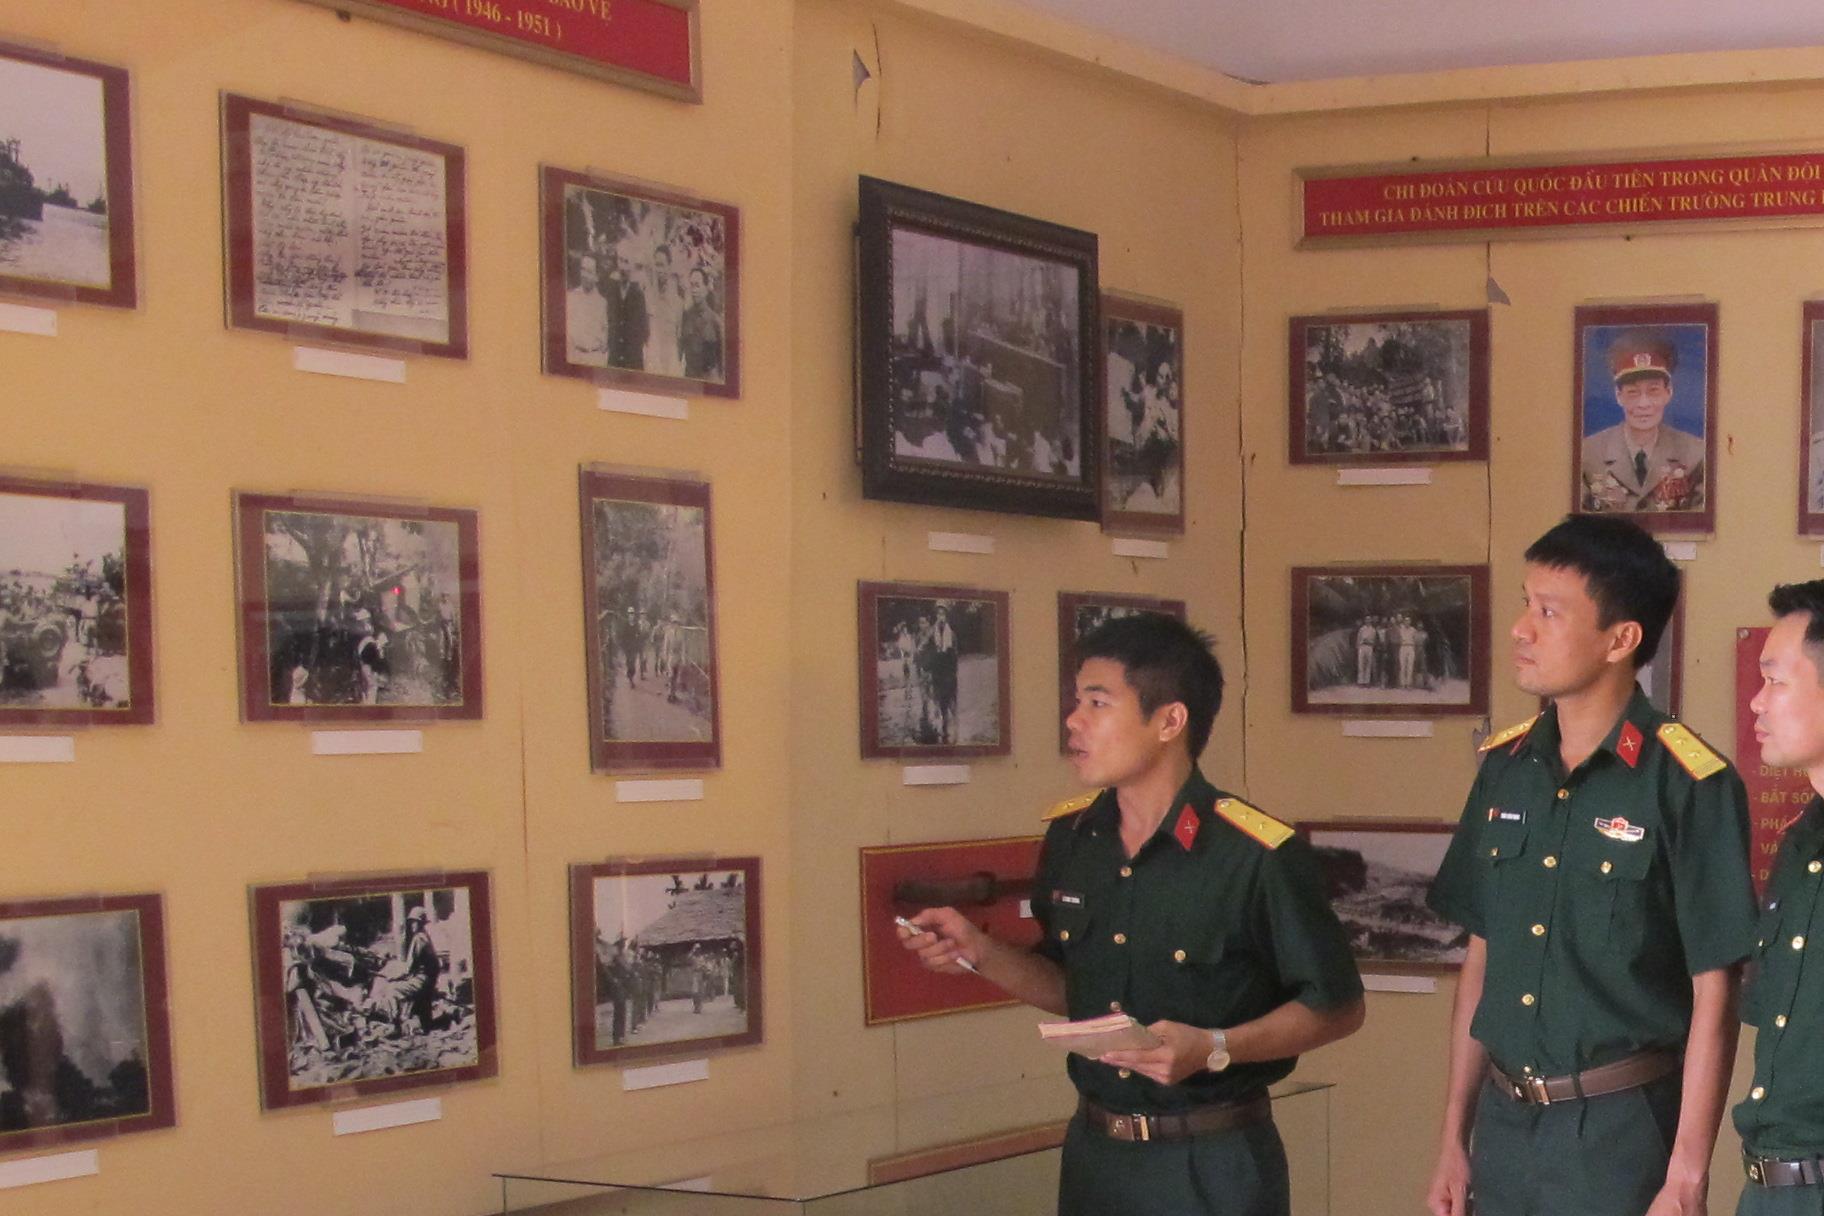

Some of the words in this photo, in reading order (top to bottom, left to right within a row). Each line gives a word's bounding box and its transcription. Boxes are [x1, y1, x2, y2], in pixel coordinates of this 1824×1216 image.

[466, 0, 501, 22] 1946
[517, 10, 550, 36] 1951
[1383, 182, 1415, 200] CHI
[1514, 170, 1565, 196] QUỐC
[1569, 169, 1607, 191] ĐẦU
[1612, 168, 1655, 188] TIÊN
[1659, 169, 1725, 187] TRONG
[1729, 162, 1783, 186] QUÂN
[1787, 161, 1821, 184] ĐỘI
[1319, 209, 1370, 227] THAM
[1374, 207, 1404, 223] GIA
[1409, 201, 1458, 222] ĐÁNH
[1463, 203, 1508, 223] ĐỊCH
[1512, 196, 1559, 218] TRÊN
[1563, 195, 1602, 217] CÁC
[1605, 191, 1663, 214] CHIẾN
[1667, 190, 1746, 213] TRƯỜNG
[1750, 190, 1816, 209] TRUNG
